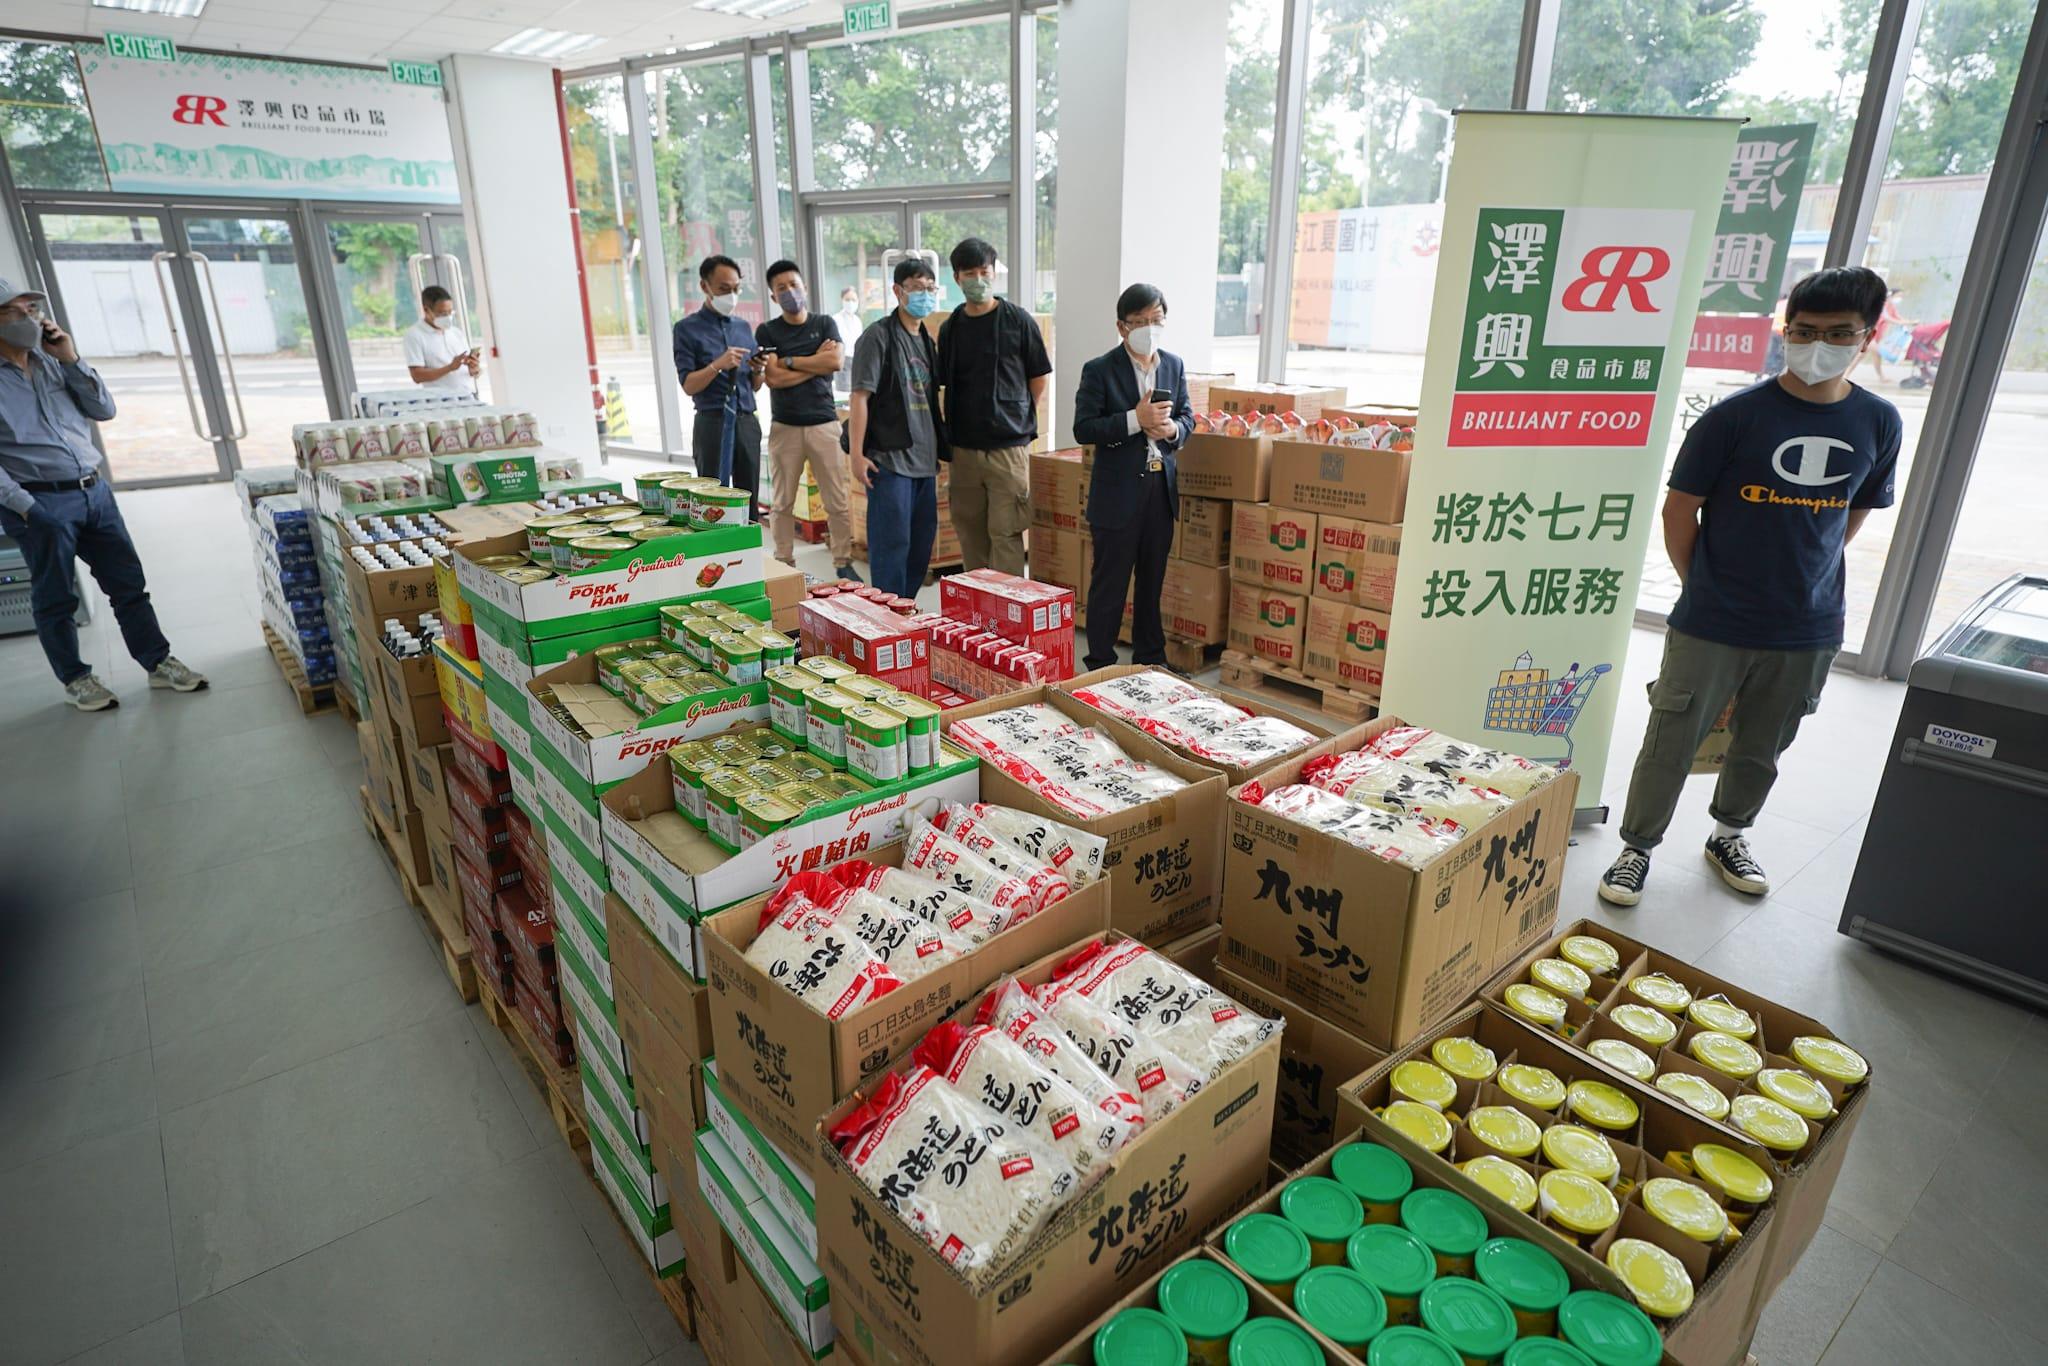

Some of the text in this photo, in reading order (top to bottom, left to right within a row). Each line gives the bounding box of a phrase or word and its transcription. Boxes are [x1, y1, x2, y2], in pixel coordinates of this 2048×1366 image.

[847, 6, 871, 32] EXIT
[110, 34, 146, 57] EXIT
[393, 64, 420, 84] EXIT
[241, 121, 389, 137] BRILLIANT FOOD SUPERMARKET
[1470, 222, 1548, 381] 澤興
[1550, 357, 1652, 380] 食品市場
[1461, 410, 1642, 432] BRILLIANT FOOD
[1431, 491, 1635, 544] 將於七月
[627, 553, 686, 582] Greatwall
[568, 583, 620, 600] PORK
[590, 593, 630, 608] HAM
[1421, 567, 1625, 619] 投入服務
[685, 692, 751, 728] Greatwall
[618, 734, 686, 761] PORK
[1932, 727, 1985, 747] DOYOSL
[846, 792, 908, 832] Greatwall
[773, 831, 871, 883] 火腿豬肉
[1134, 838, 1192, 885] 北海道
[1477, 808, 1542, 903] 九州
[1151, 871, 1192, 903] うどん
[1253, 859, 1344, 940] 九州
[1503, 858, 1547, 915] ラーメン
[953, 914, 969, 927] 100%
[1296, 923, 1372, 985] ラーメン
[1085, 971, 1108, 993] nittin
[736, 1010, 792, 1082] 北海道
[754, 1059, 796, 1107] うどん
[867, 1077, 927, 1150] nittin noodle
[1056, 1119, 1076, 1134] 100%
[878, 1115, 962, 1215] 北海道
[941, 1123, 1005, 1189] うどん
[1088, 1153, 1190, 1265] 北海道
[851, 1196, 920, 1295] 北海道
[1114, 1206, 1188, 1282] うどん
[869, 1254, 922, 1323] うどん
